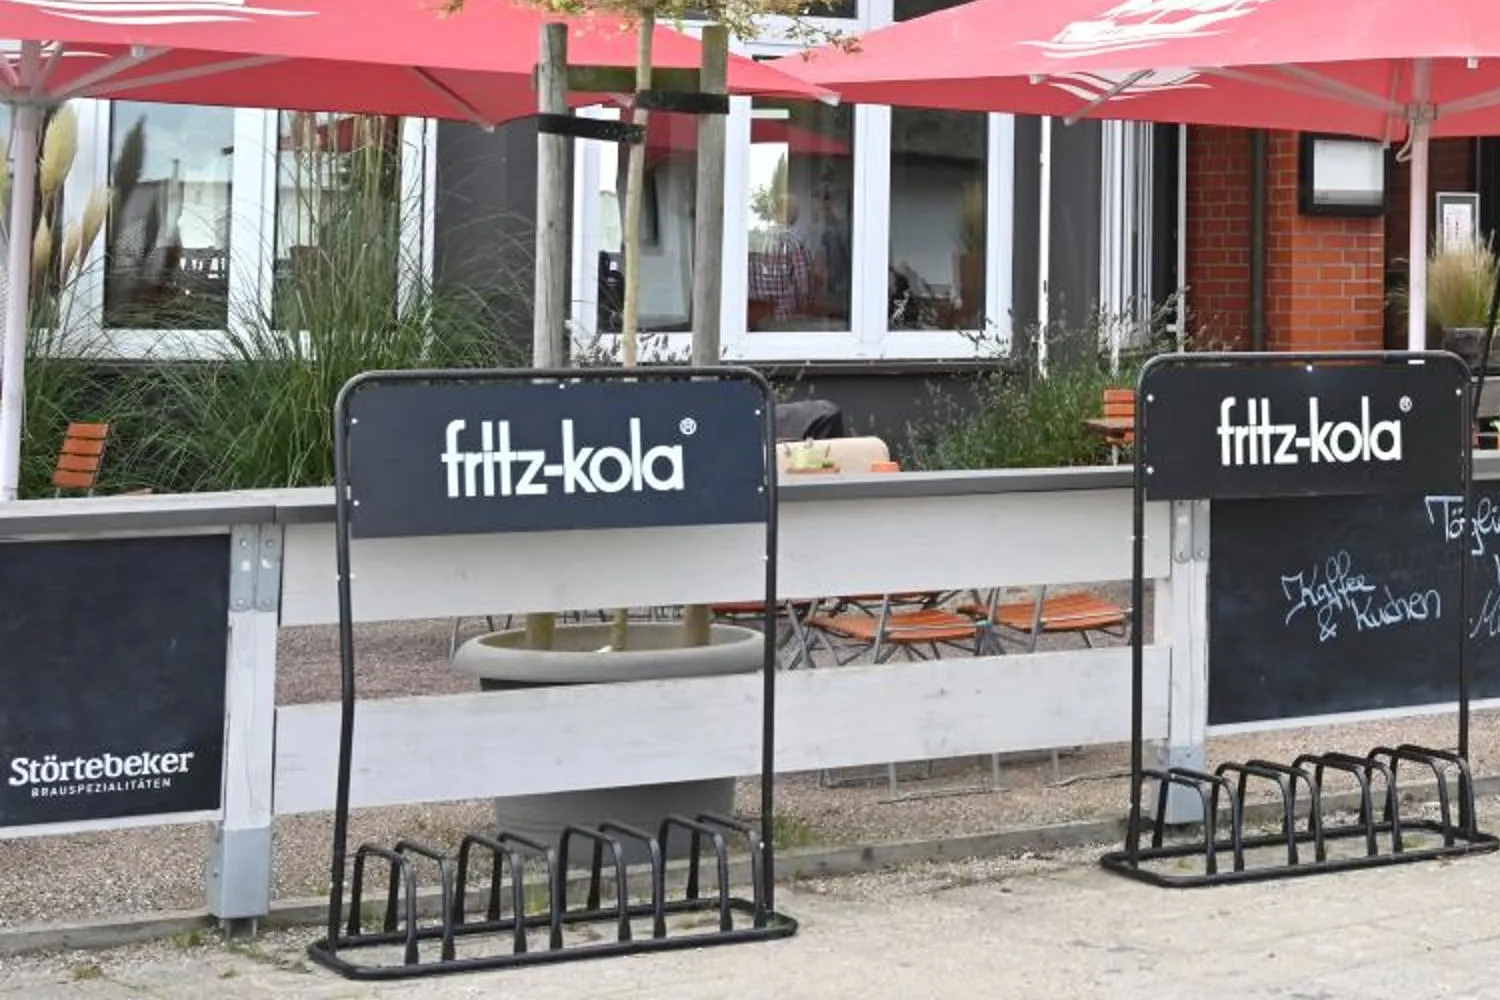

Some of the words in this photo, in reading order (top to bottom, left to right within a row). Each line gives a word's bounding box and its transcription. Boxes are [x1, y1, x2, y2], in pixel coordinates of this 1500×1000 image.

[1280, 551, 1376, 626] Kaffee
[8, 751, 195, 786] Störtebeker
[31, 777, 172, 798] BRAUSPEZIALITÄTEN
